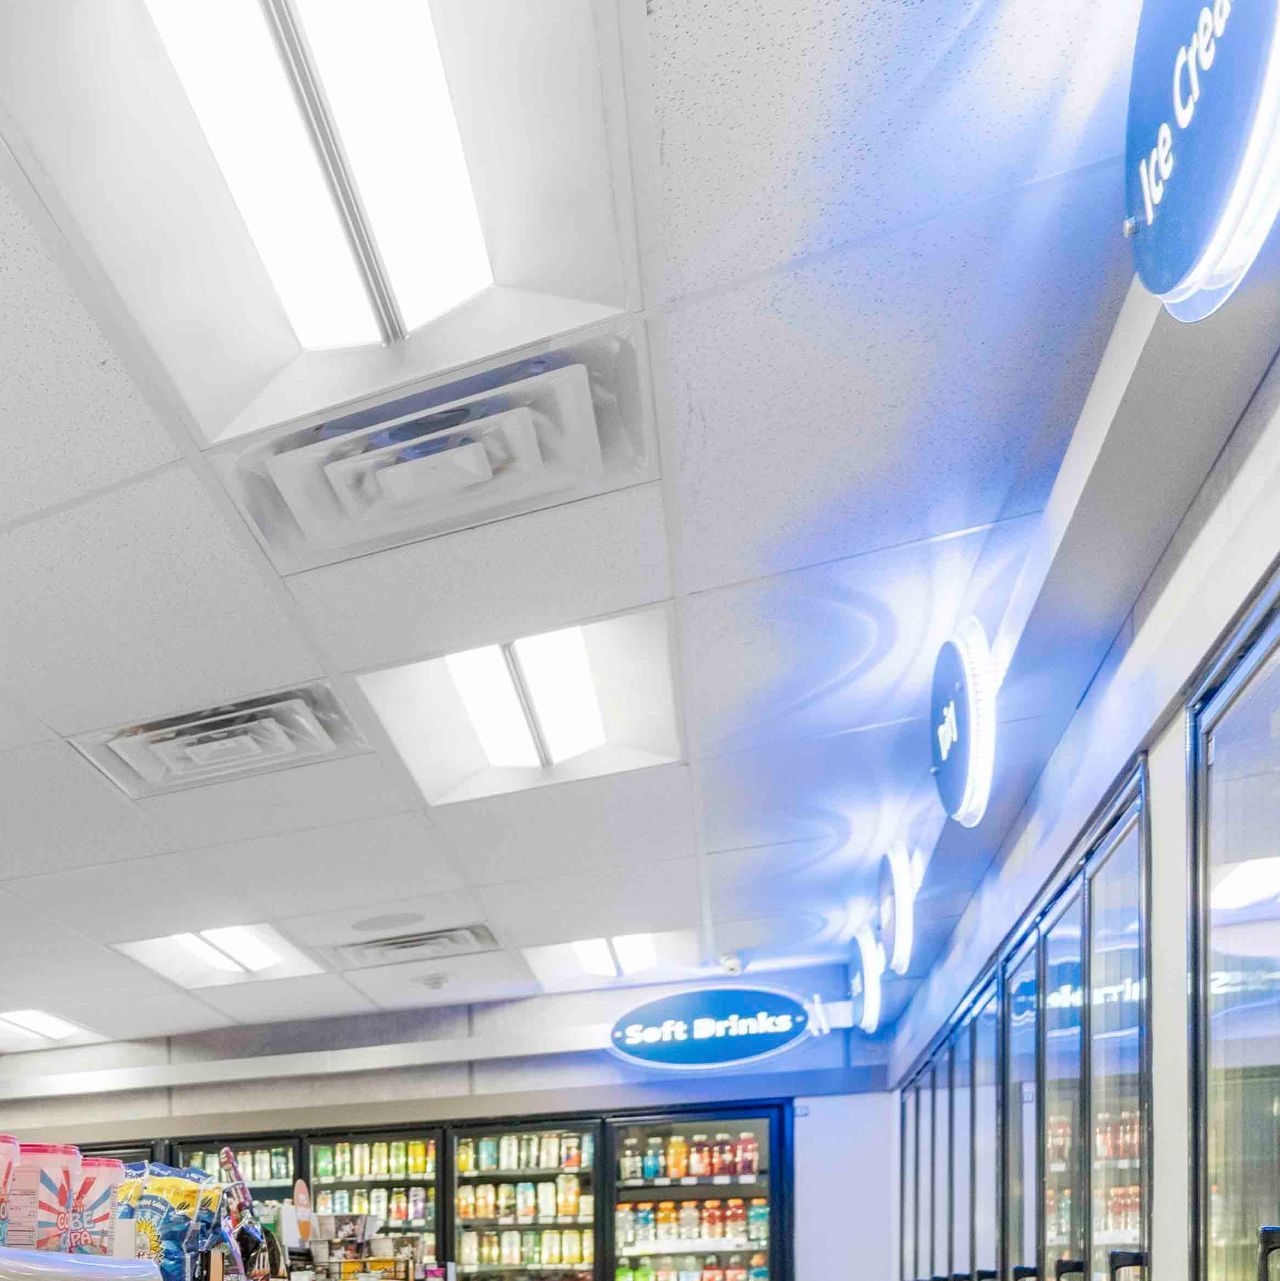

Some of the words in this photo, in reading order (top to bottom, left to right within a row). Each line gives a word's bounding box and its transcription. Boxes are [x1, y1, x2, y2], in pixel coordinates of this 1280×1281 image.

[1139, 122, 1174, 226] Ice
[624, 1018, 689, 1045] Soft
[693, 1011, 793, 1041] Drinks
